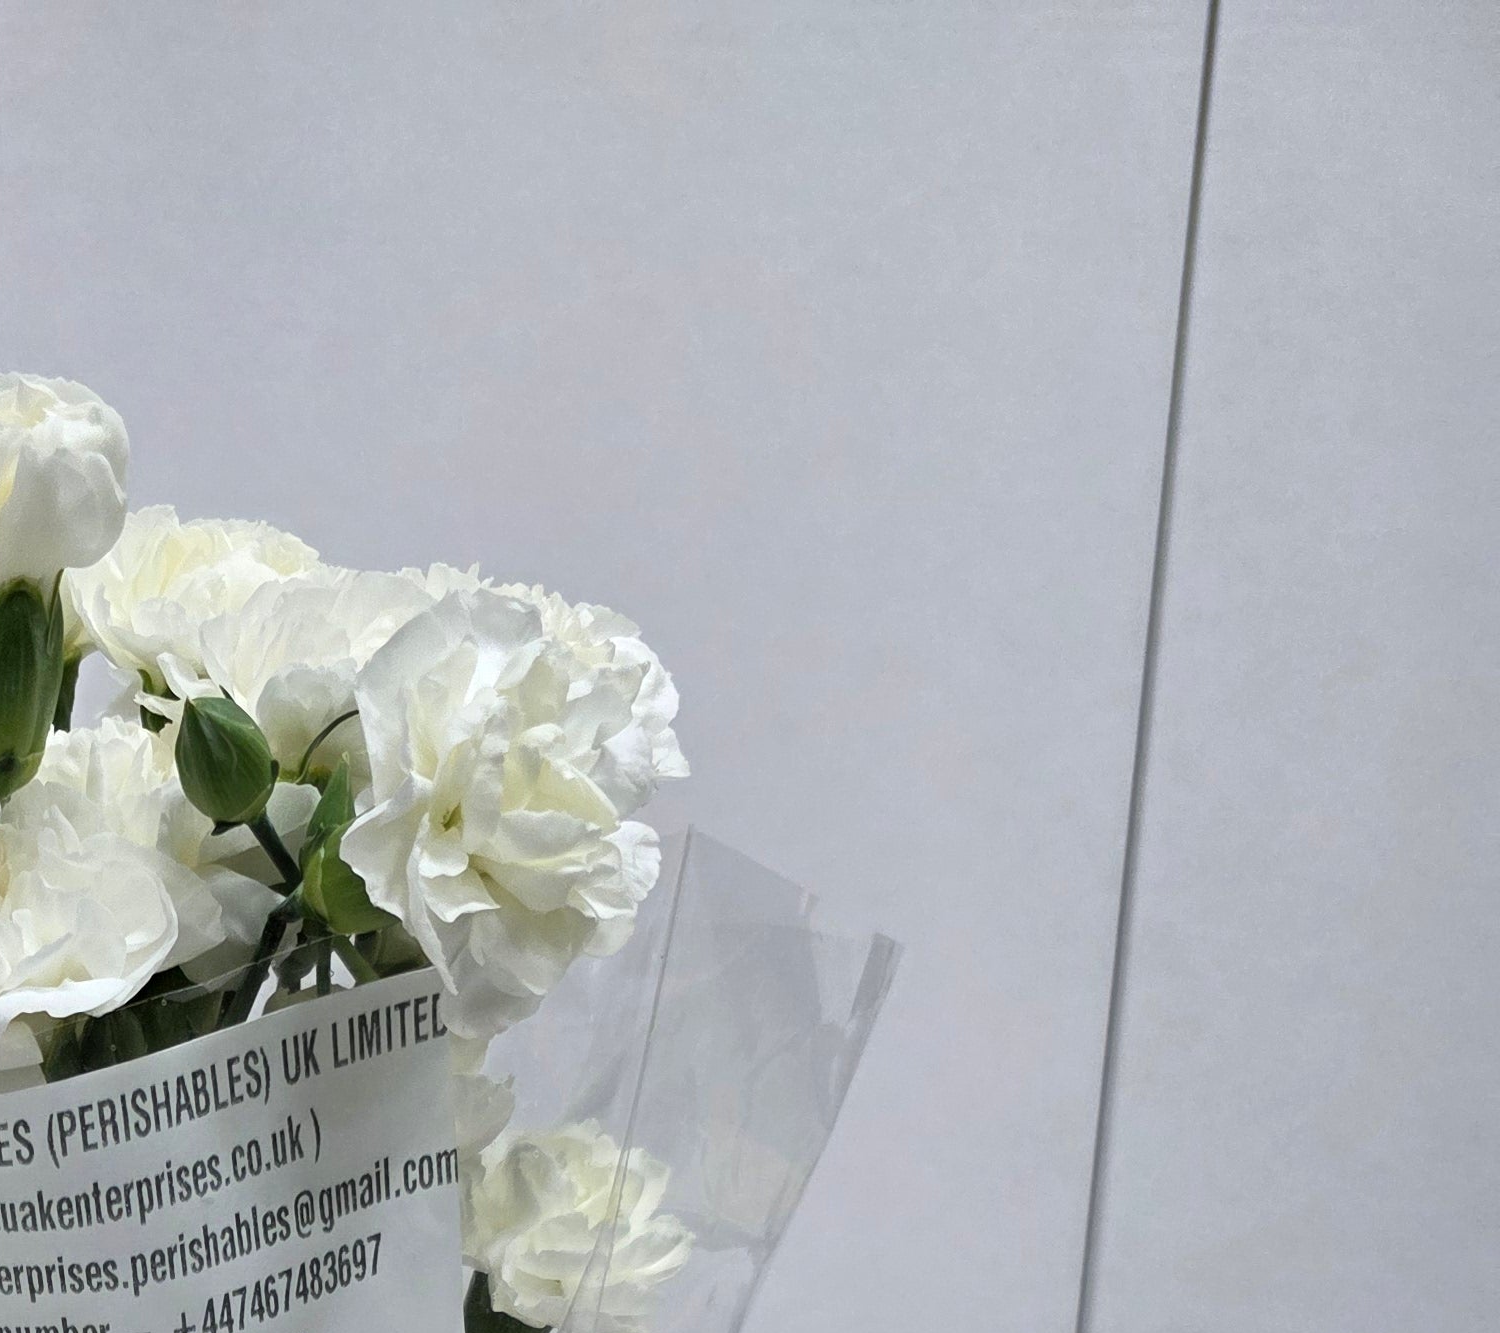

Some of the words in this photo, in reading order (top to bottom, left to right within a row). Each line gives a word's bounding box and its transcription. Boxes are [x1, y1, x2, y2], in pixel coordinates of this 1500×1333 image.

[47, 1051, 271, 1170] (PERISHABLES)
[282, 1031, 320, 1085] UK
[310, 1108, 320, 1163] )
